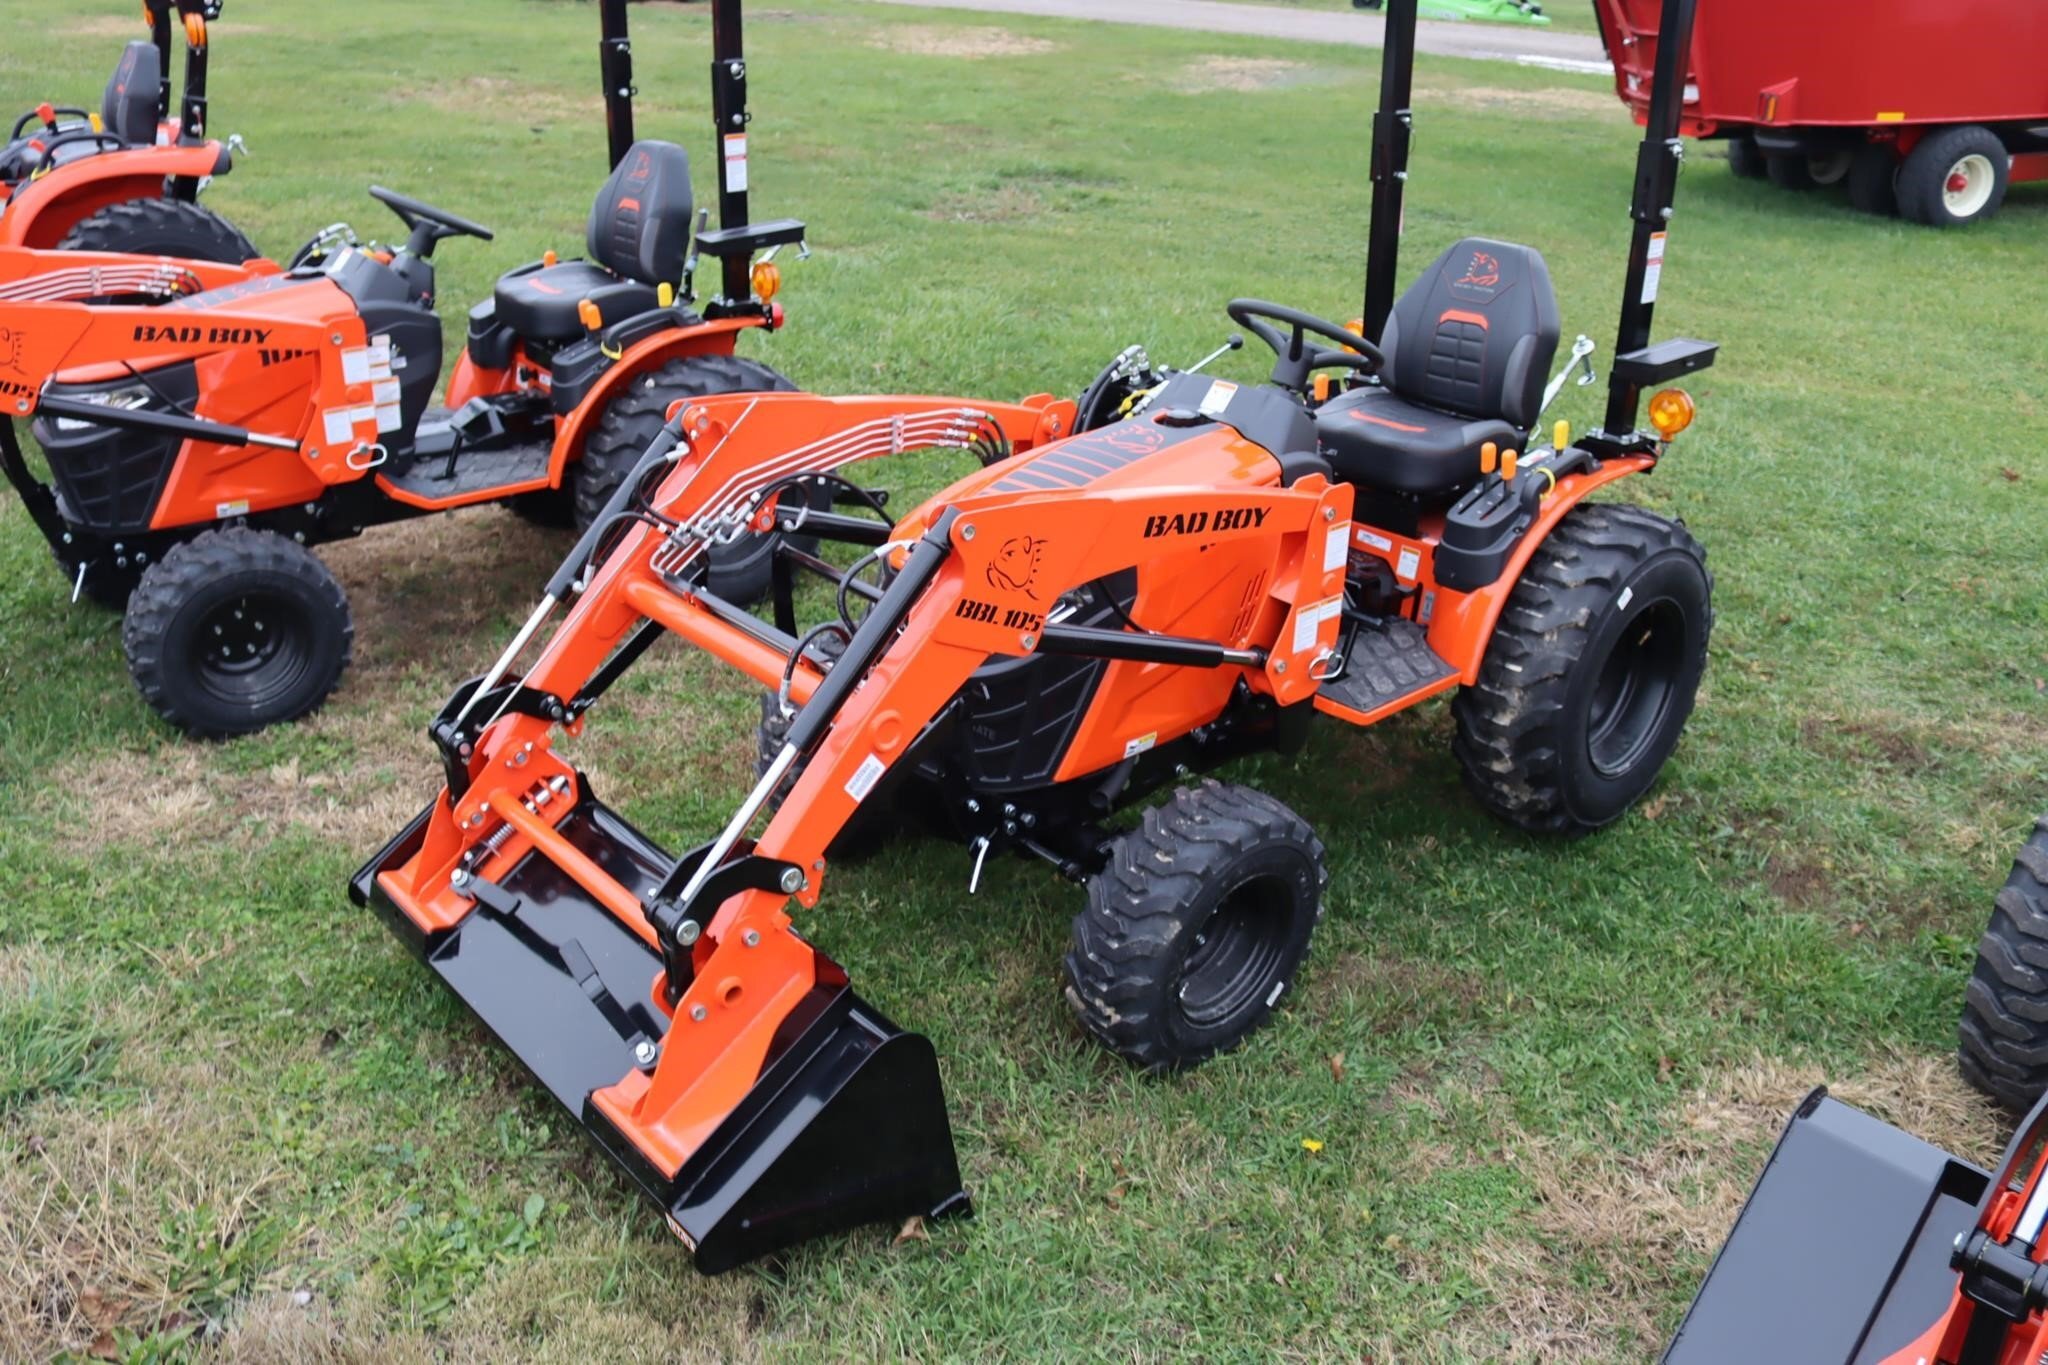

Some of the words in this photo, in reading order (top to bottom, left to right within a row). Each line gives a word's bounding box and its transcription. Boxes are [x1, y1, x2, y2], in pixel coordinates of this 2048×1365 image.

[133, 326, 201, 343] BAD
[208, 328, 273, 344] BOY
[1143, 511, 1209, 538] BAD
[1212, 506, 1272, 532] BOY
[955, 598, 998, 625] BBL
[1003, 609, 1045, 632] 105
